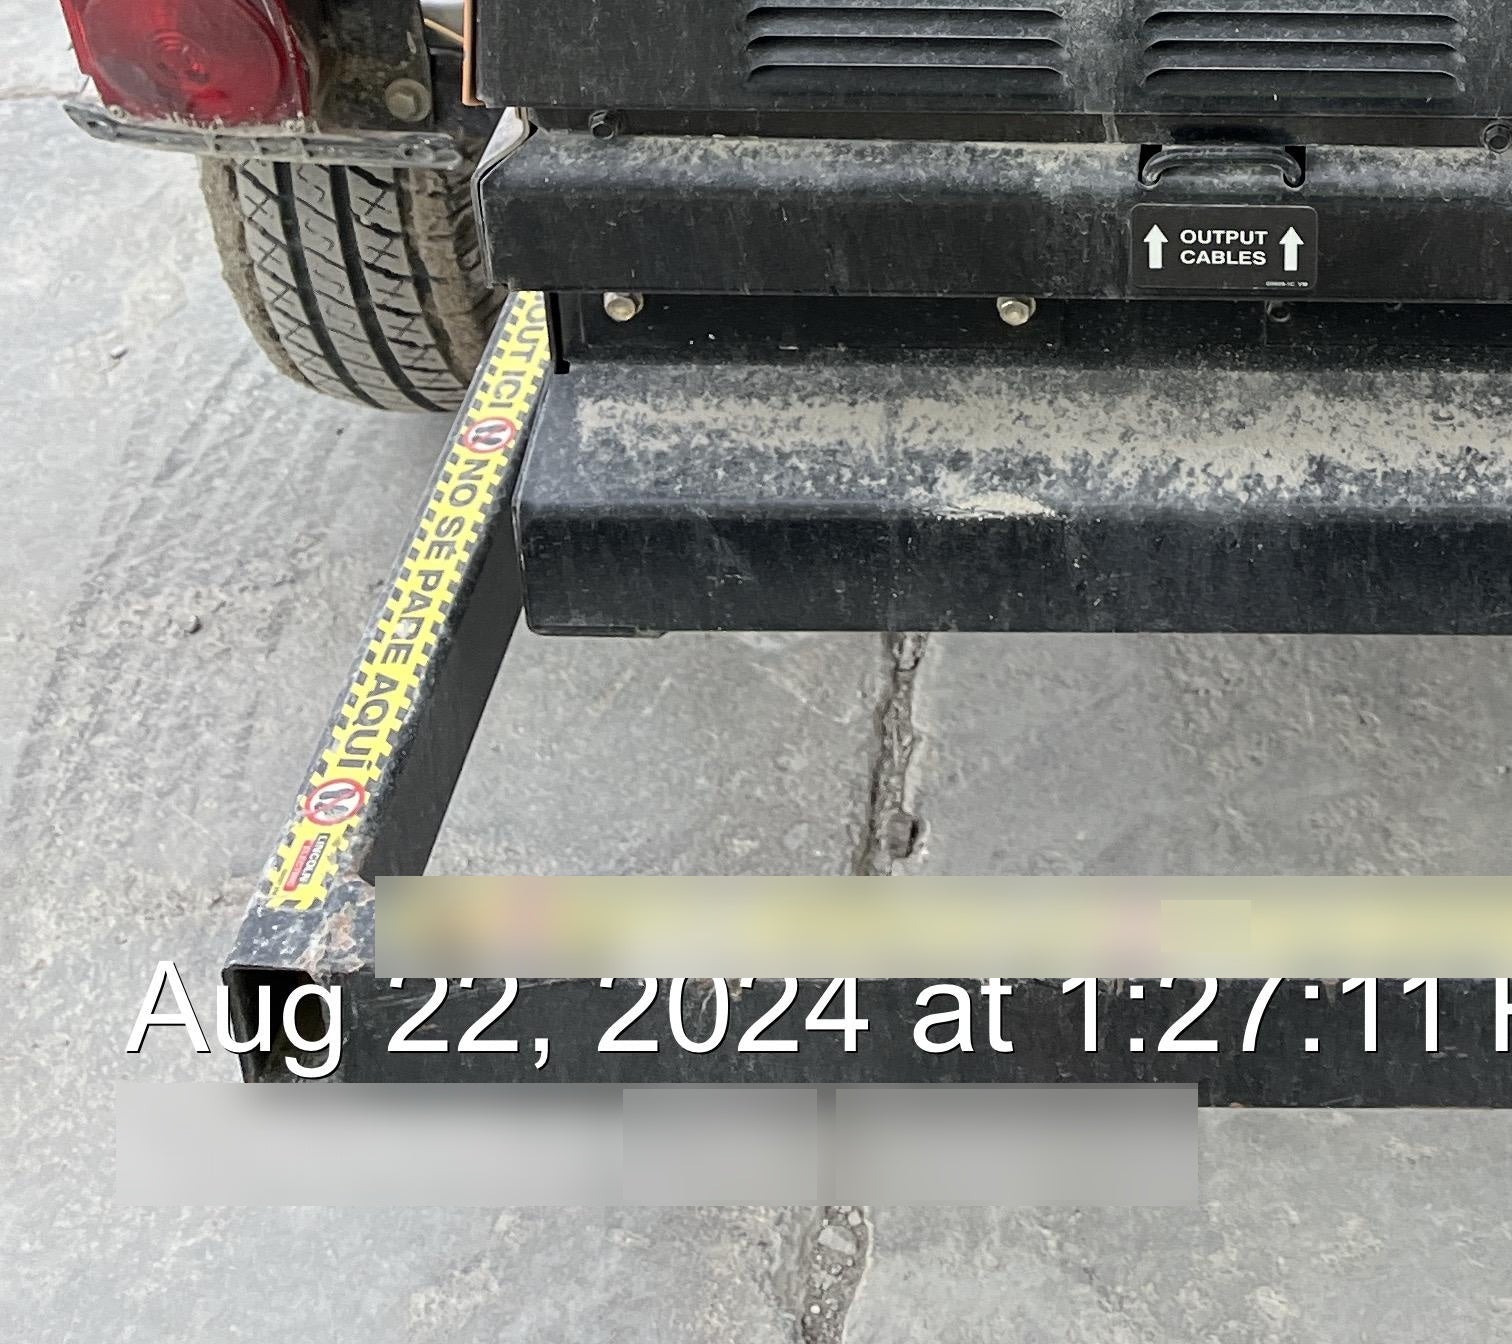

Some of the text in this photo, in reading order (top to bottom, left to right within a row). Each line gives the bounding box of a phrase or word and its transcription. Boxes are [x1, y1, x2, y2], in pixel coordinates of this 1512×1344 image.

[1179, 229, 1269, 245] OUTPUT
[1179, 250, 1267, 266] CABLES
[488, 303, 546, 408] OUT ICI
[449, 459, 491, 507] NO
[424, 515, 465, 561] SE
[380, 570, 445, 665] PARE
